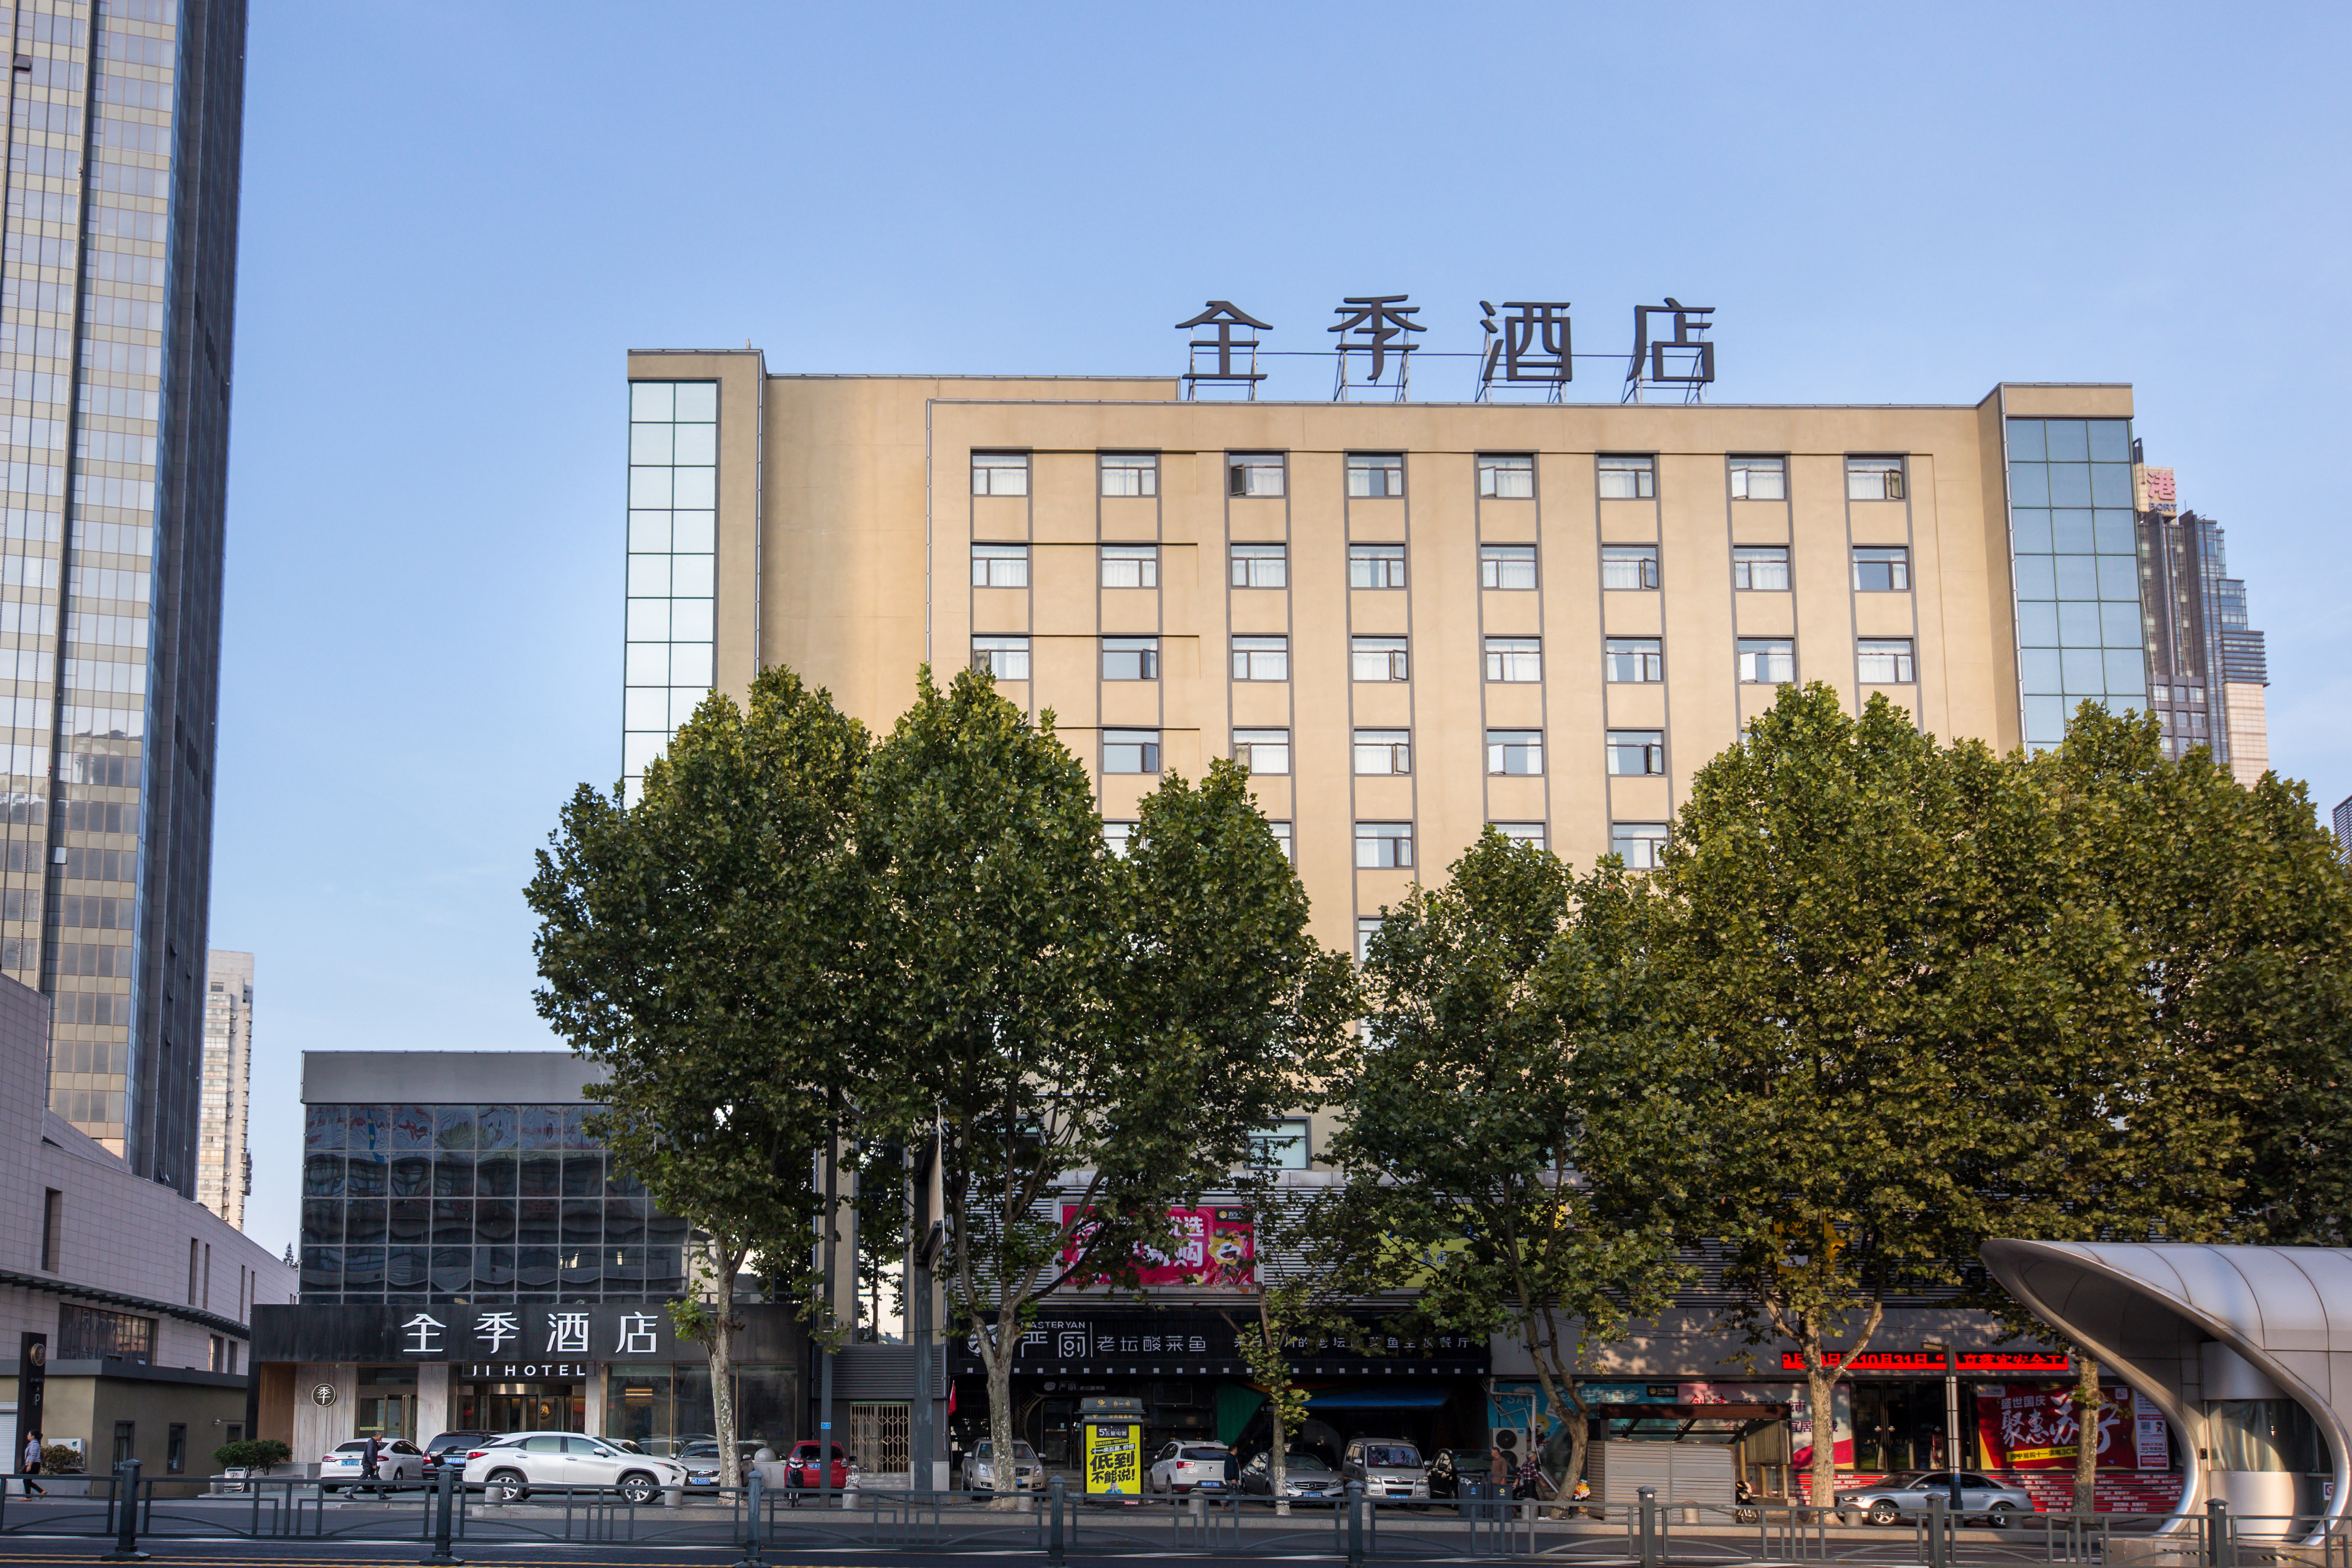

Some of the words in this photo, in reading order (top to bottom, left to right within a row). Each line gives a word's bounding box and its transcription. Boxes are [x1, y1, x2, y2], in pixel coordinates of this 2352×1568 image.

[1175, 294, 1716, 382] 全季酒店
[2147, 471, 2176, 500] 港
[2149, 502, 2177, 512] PORT
[401, 1311, 658, 1354] 全季酒店
[1021, 1331, 1086, 1358] 严厨
[1096, 1336, 1206, 1352] 老坛酸菜鱼
[472, 1365, 490, 1377] JI
[504, 1364, 585, 1377] HOTEL
[317, 1387, 331, 1406] 季
[2001, 1395, 2045, 1409] 盛世国庆
[1090, 1451, 1135, 1472] 低到
